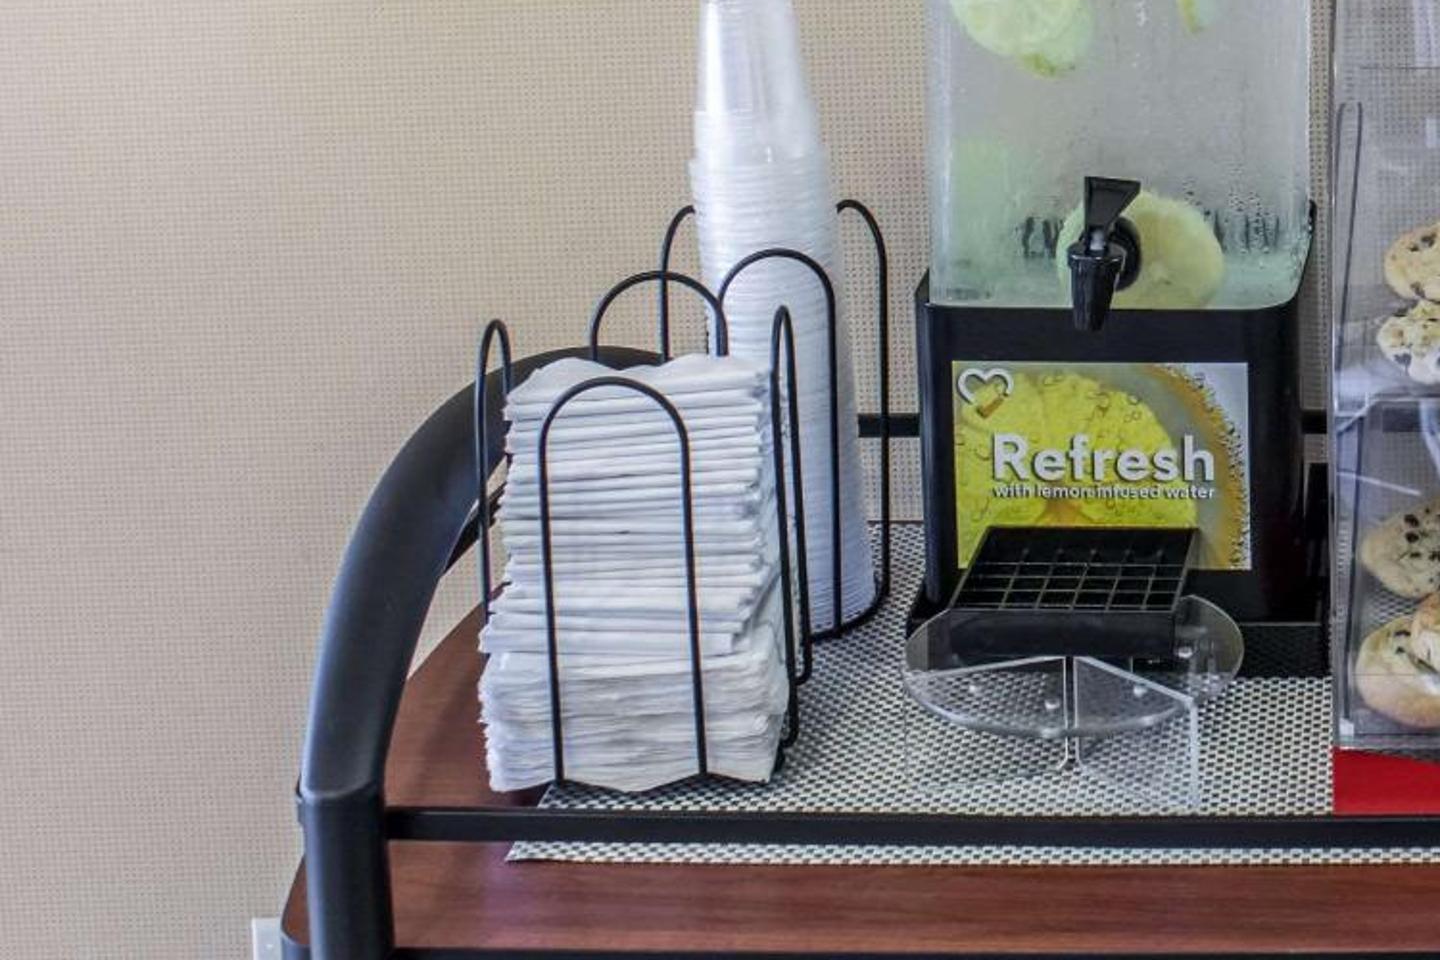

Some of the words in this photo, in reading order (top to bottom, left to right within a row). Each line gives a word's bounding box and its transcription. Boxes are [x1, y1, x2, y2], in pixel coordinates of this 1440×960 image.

[993, 434, 1215, 482] Refresh
[993, 483, 1031, 499] with
[1165, 485, 1215, 499] water
